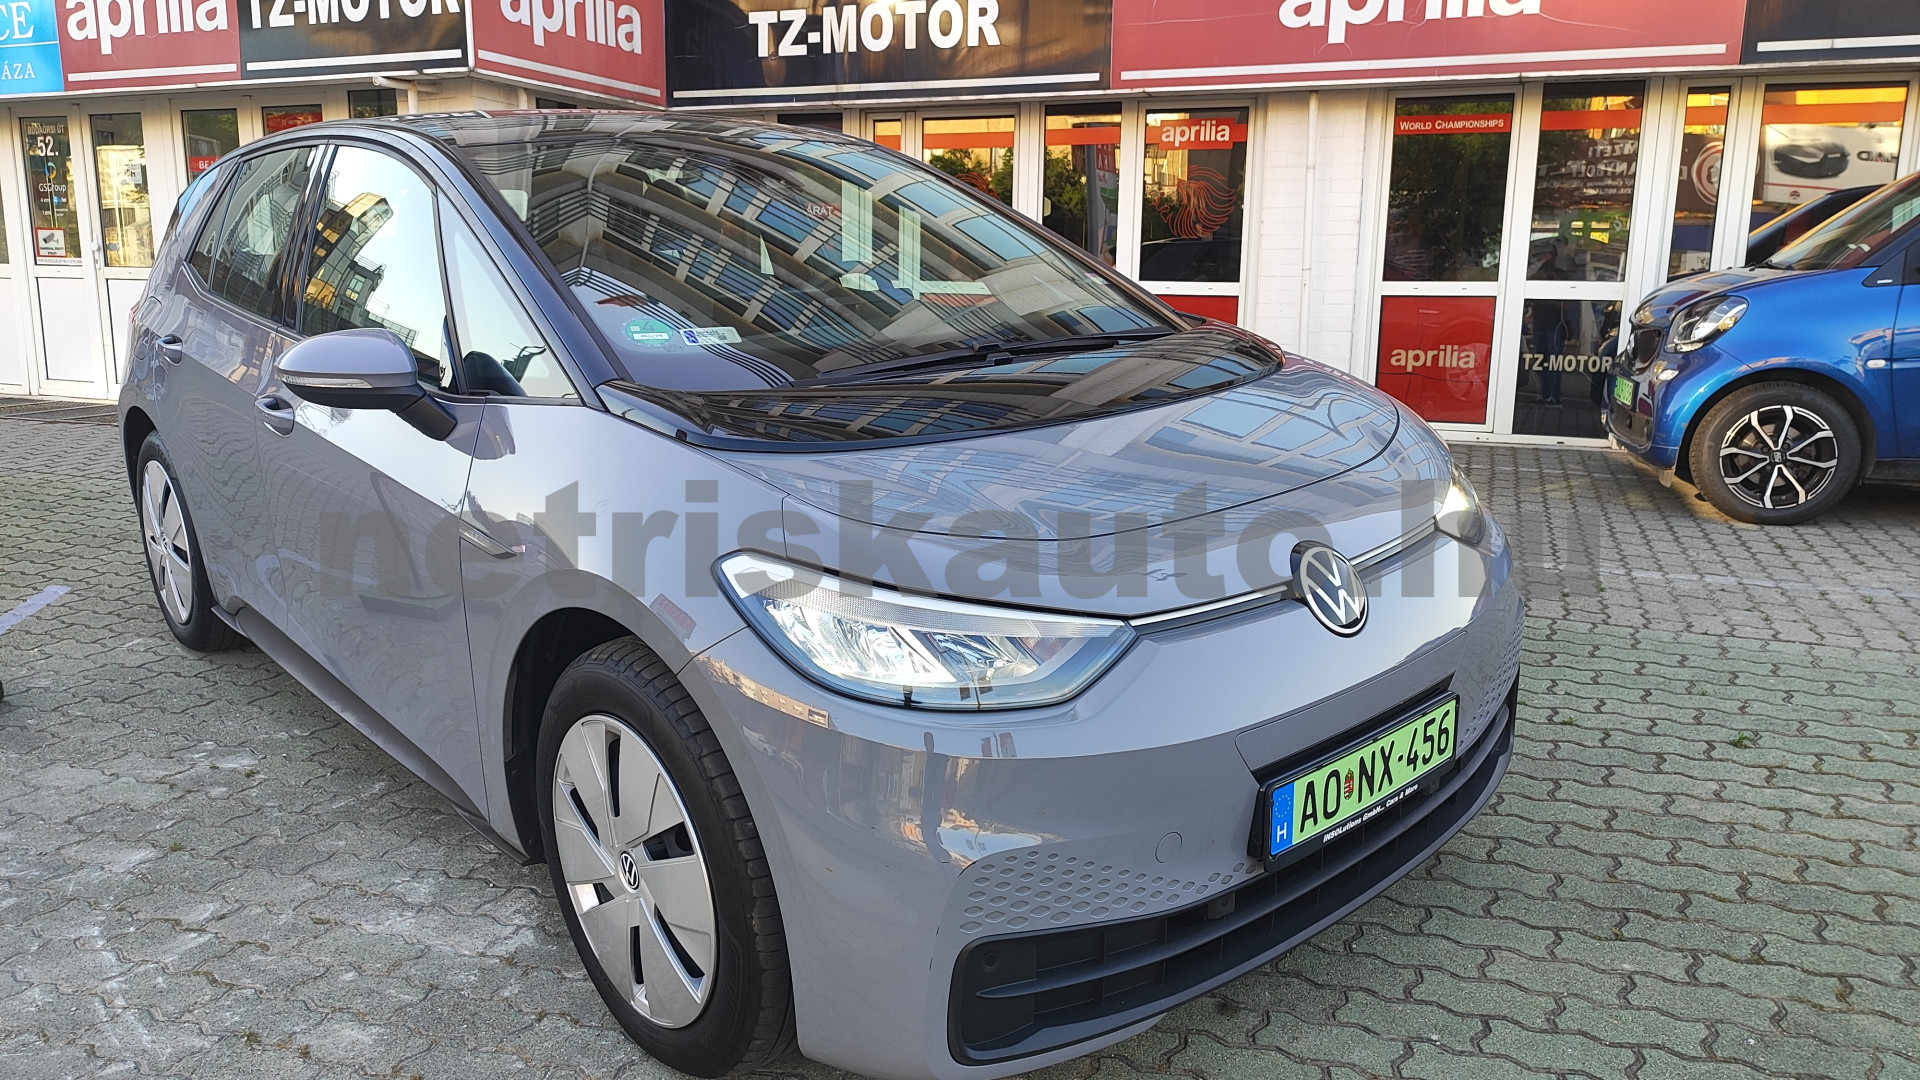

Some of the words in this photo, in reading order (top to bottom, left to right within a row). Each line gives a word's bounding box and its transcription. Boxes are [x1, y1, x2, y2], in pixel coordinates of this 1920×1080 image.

[65, 0, 229, 55] aprilia
[748, 0, 1001, 58] TZ-MOTOR
[57, 123, 65, 133] ÚT
[1161, 120, 1230, 147] aprilia
[37, 135, 59, 156] 52.
[1390, 345, 1475, 372] aprilia
[1522, 353, 1613, 373] TZ-MOTOR
[1300, 768, 1341, 833] AO
[1357, 708, 1450, 803] NX-456
[1276, 822, 1287, 843] H
